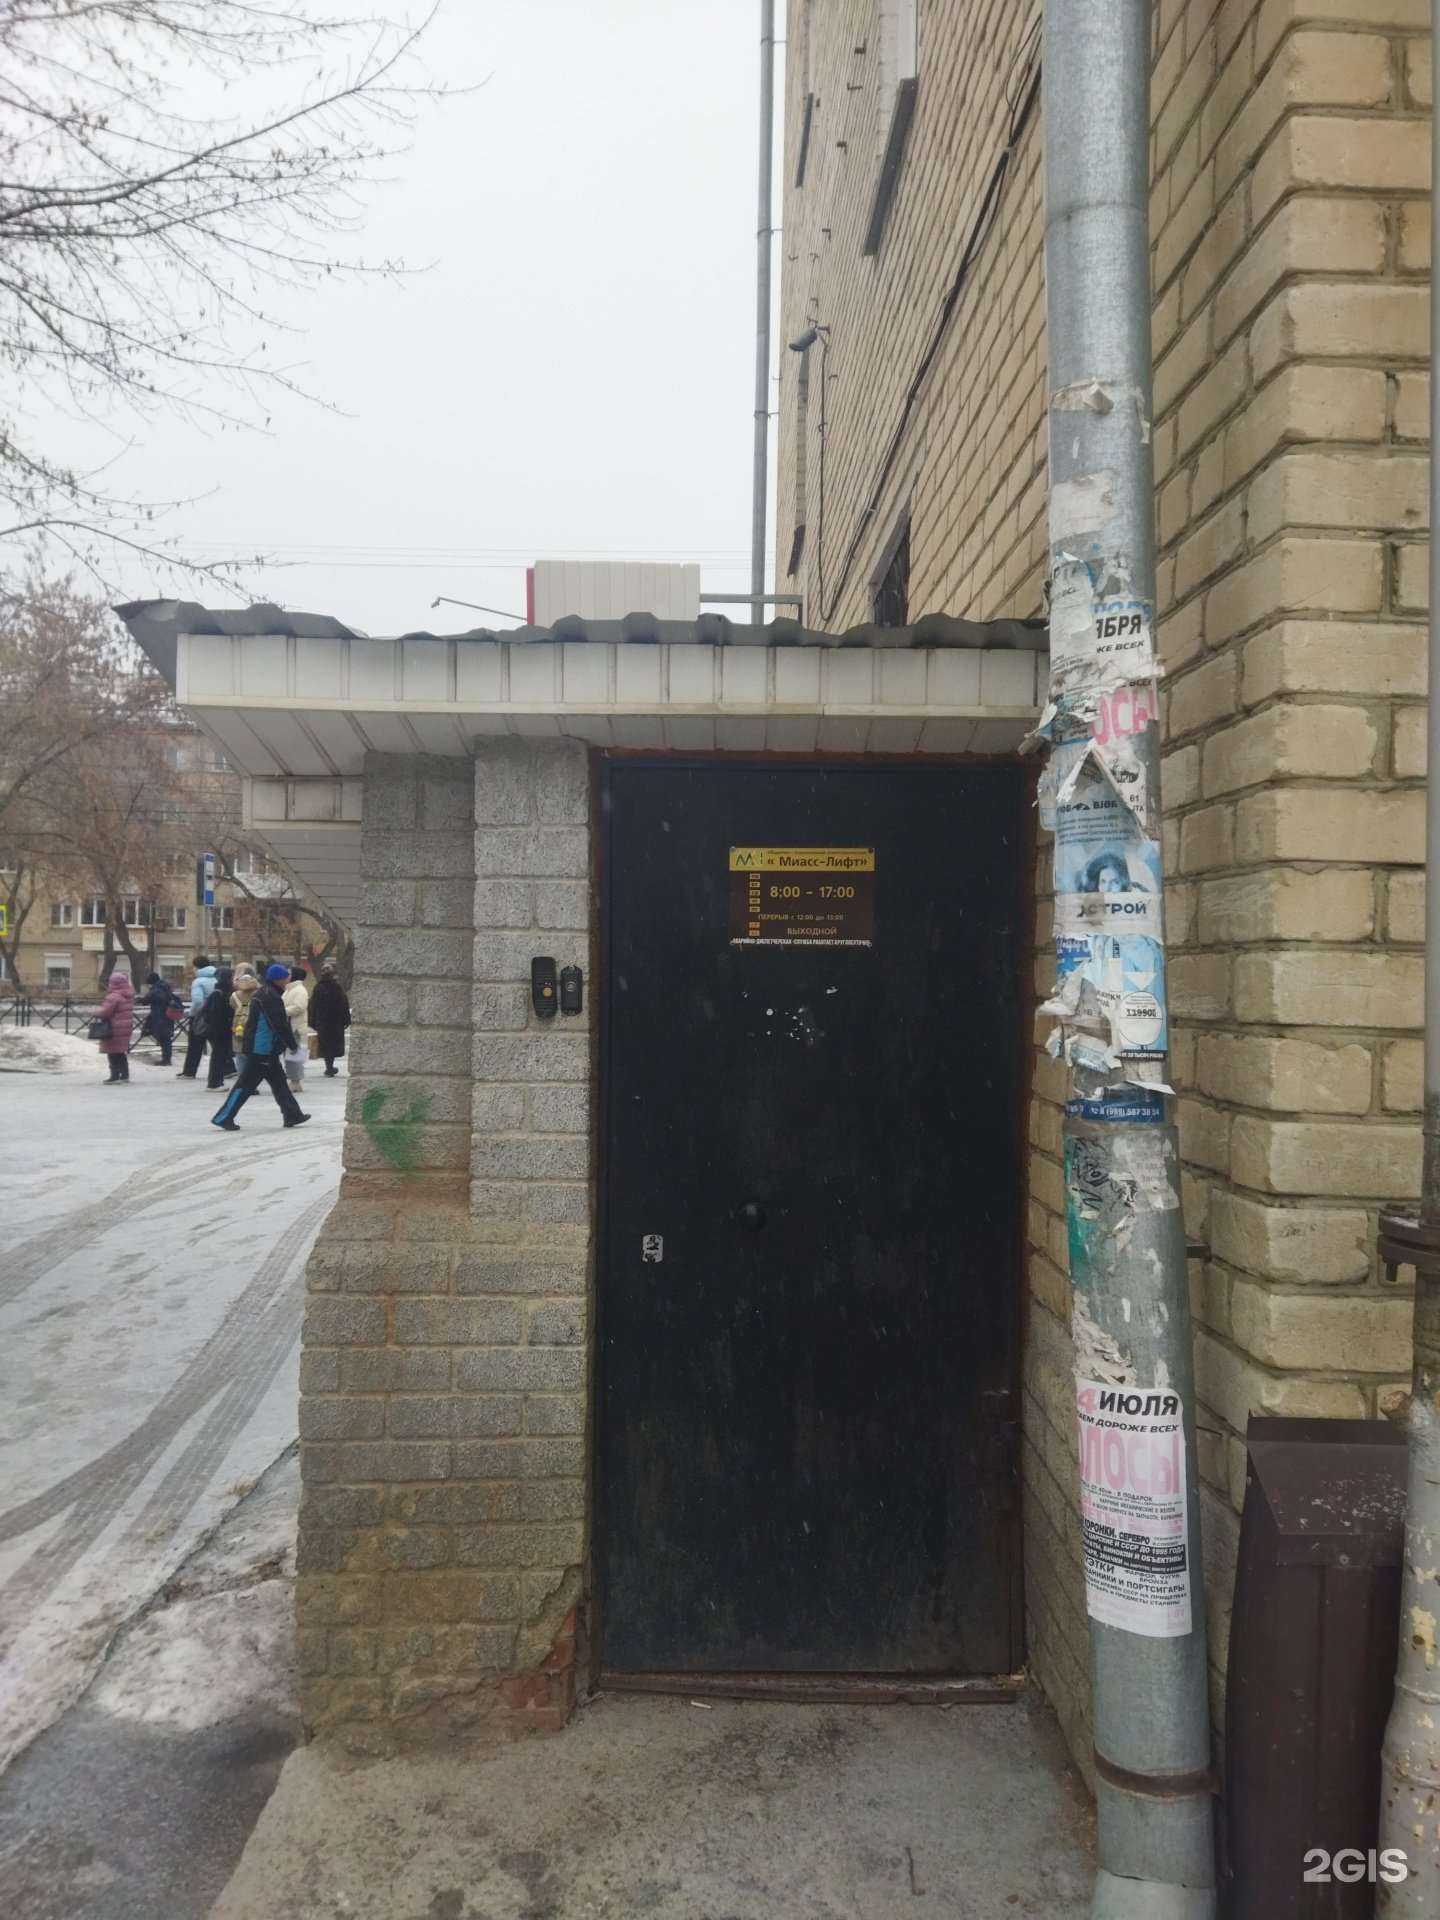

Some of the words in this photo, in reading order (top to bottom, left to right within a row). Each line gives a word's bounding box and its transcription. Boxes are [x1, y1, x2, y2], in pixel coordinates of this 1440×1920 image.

[770, 886, 801, 898] 8:00
[819, 886, 855, 898] 17:00
[787, 926, 837, 937] ВЫХОДНОЙ
[1100, 1391, 1179, 1417] ИЮЛЯ
[1096, 1418, 1148, 1432] ДОРОЖЕ
[1150, 1424, 1179, 1433] ВСЕХ
[1119, 1532, 1150, 1545] СЕРЕБРО
[1126, 1580, 1185, 1594] ПОРТСИГАРЫ
